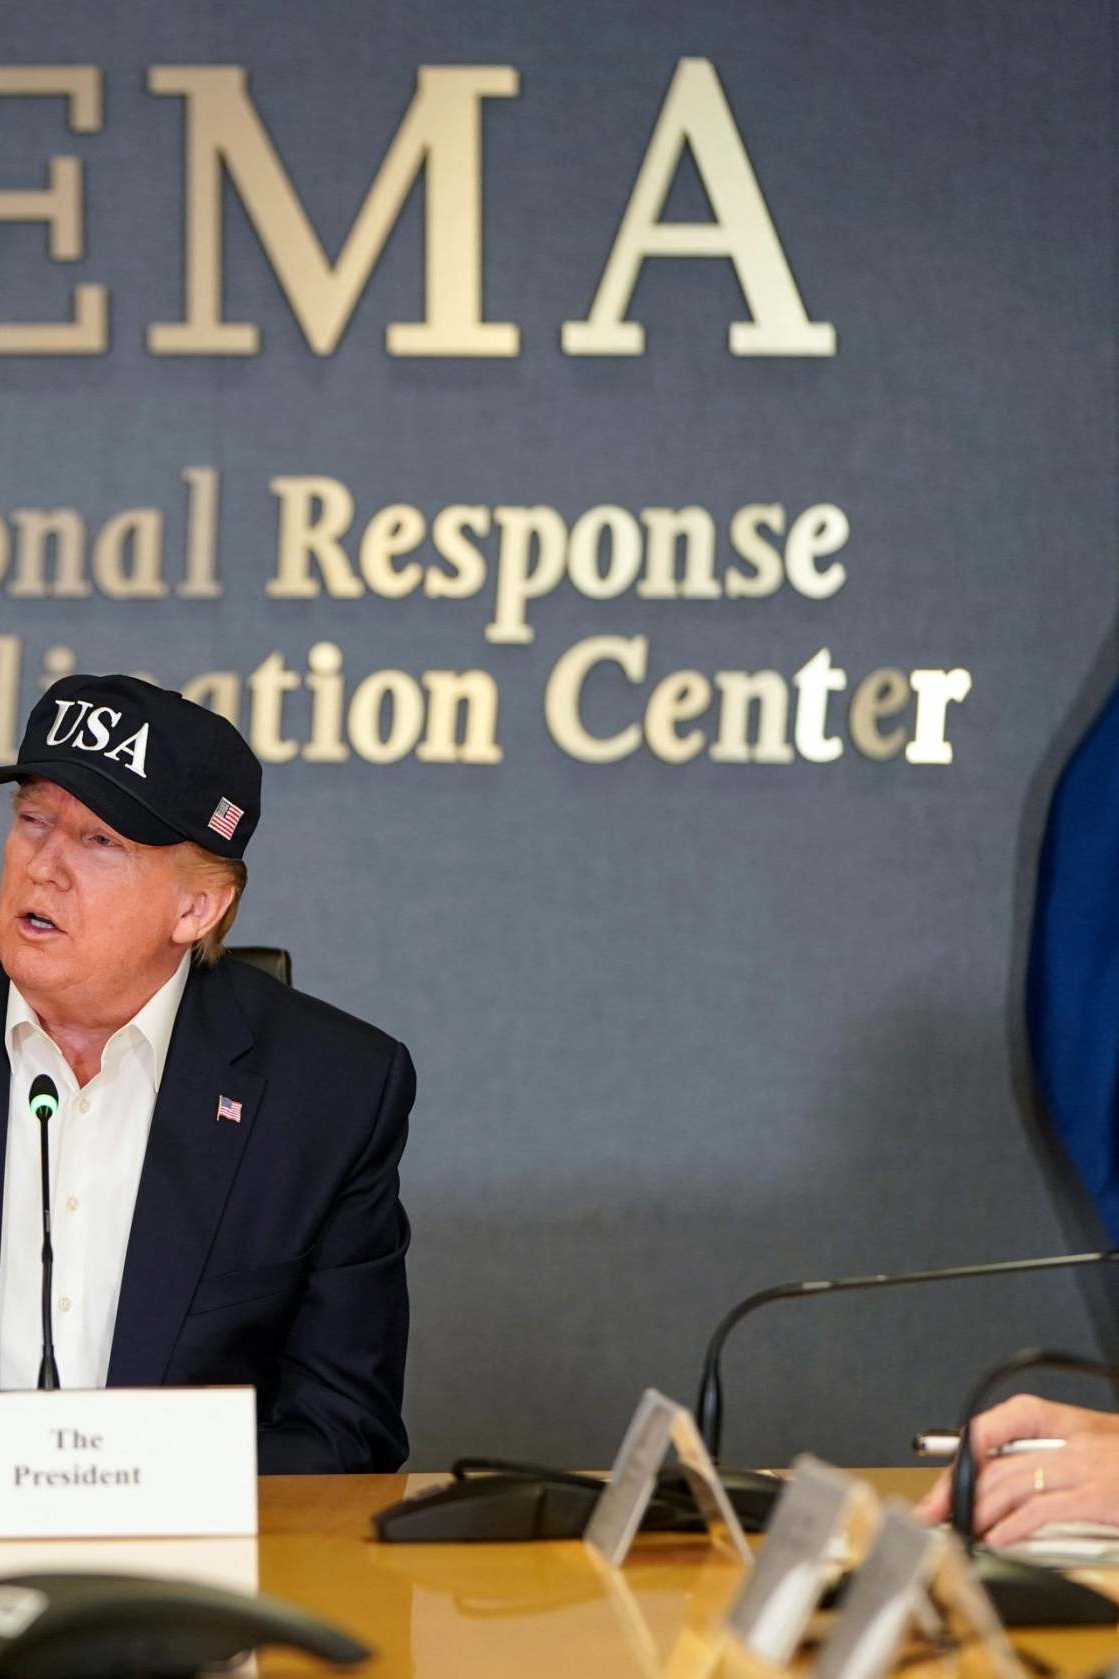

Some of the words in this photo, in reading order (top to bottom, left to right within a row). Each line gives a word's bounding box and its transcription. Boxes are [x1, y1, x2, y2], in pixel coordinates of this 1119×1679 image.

[266, 474, 850, 644] Response
[545, 633, 973, 764] Center
[46, 699, 150, 779] USA
[12, 1462, 143, 1488] President
[52, 1428, 104, 1451] The
